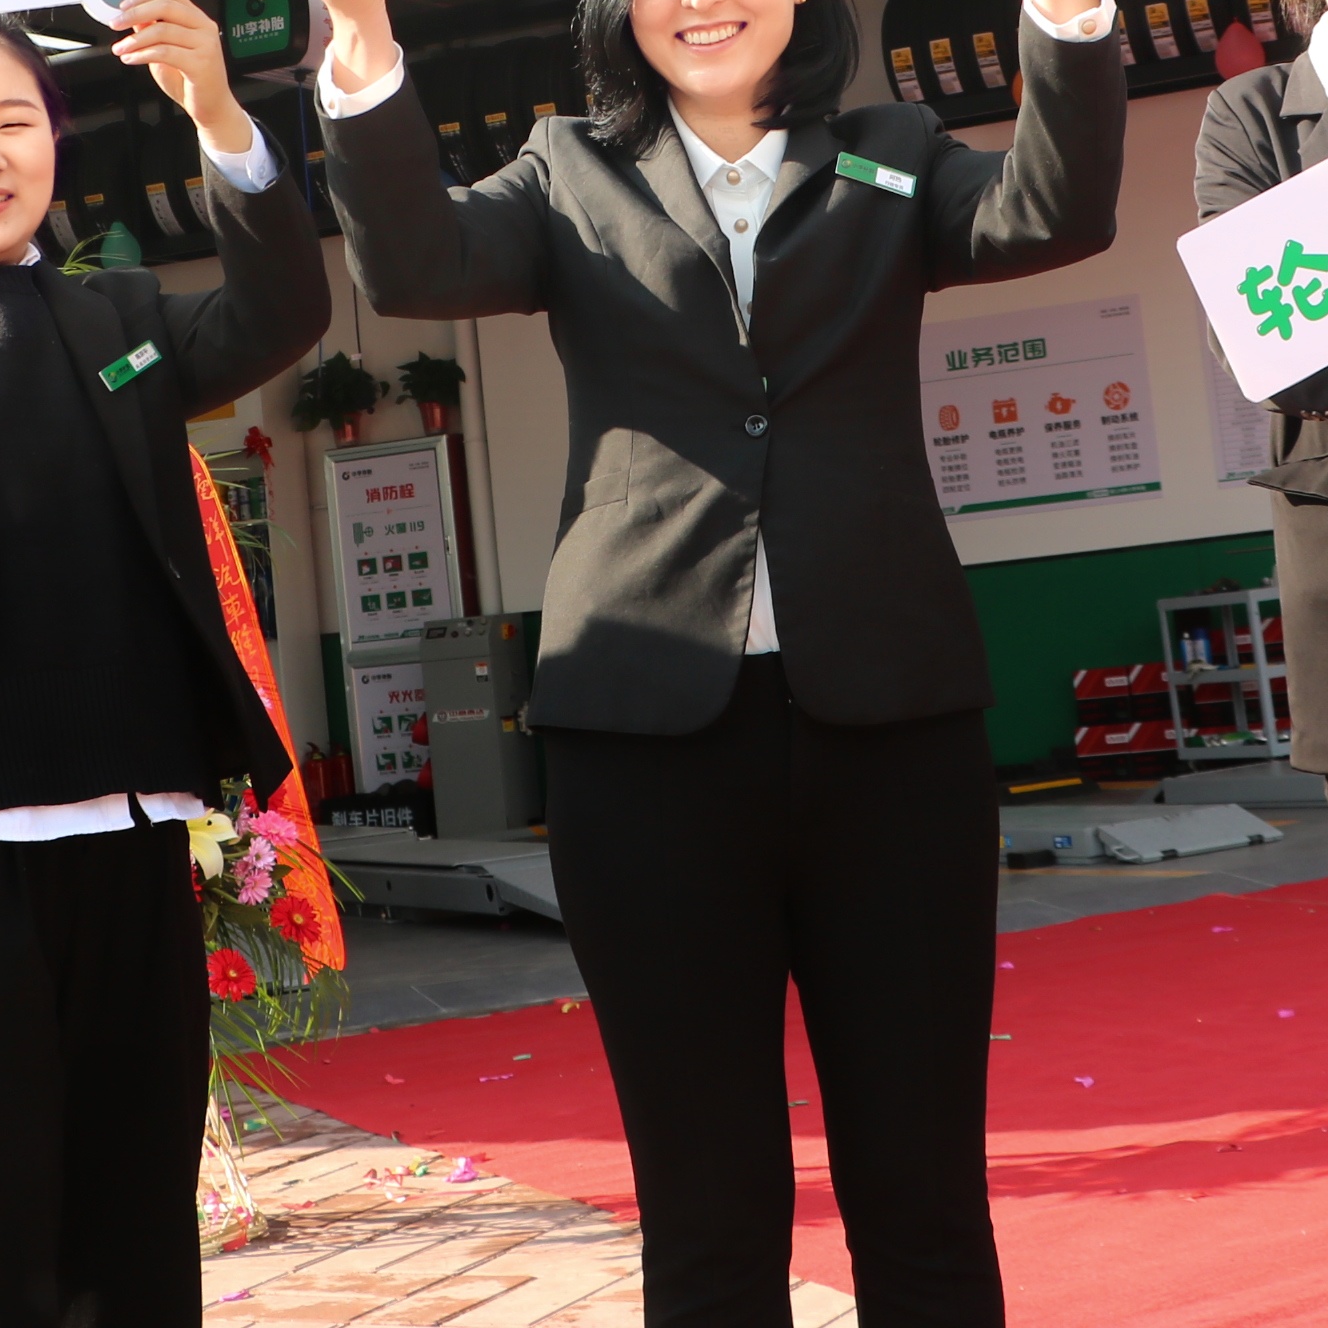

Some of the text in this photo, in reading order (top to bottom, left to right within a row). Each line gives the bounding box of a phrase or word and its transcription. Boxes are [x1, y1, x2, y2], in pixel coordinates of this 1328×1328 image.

[945, 337, 1047, 372] 业务范围
[365, 483, 416, 504] 消防栓
